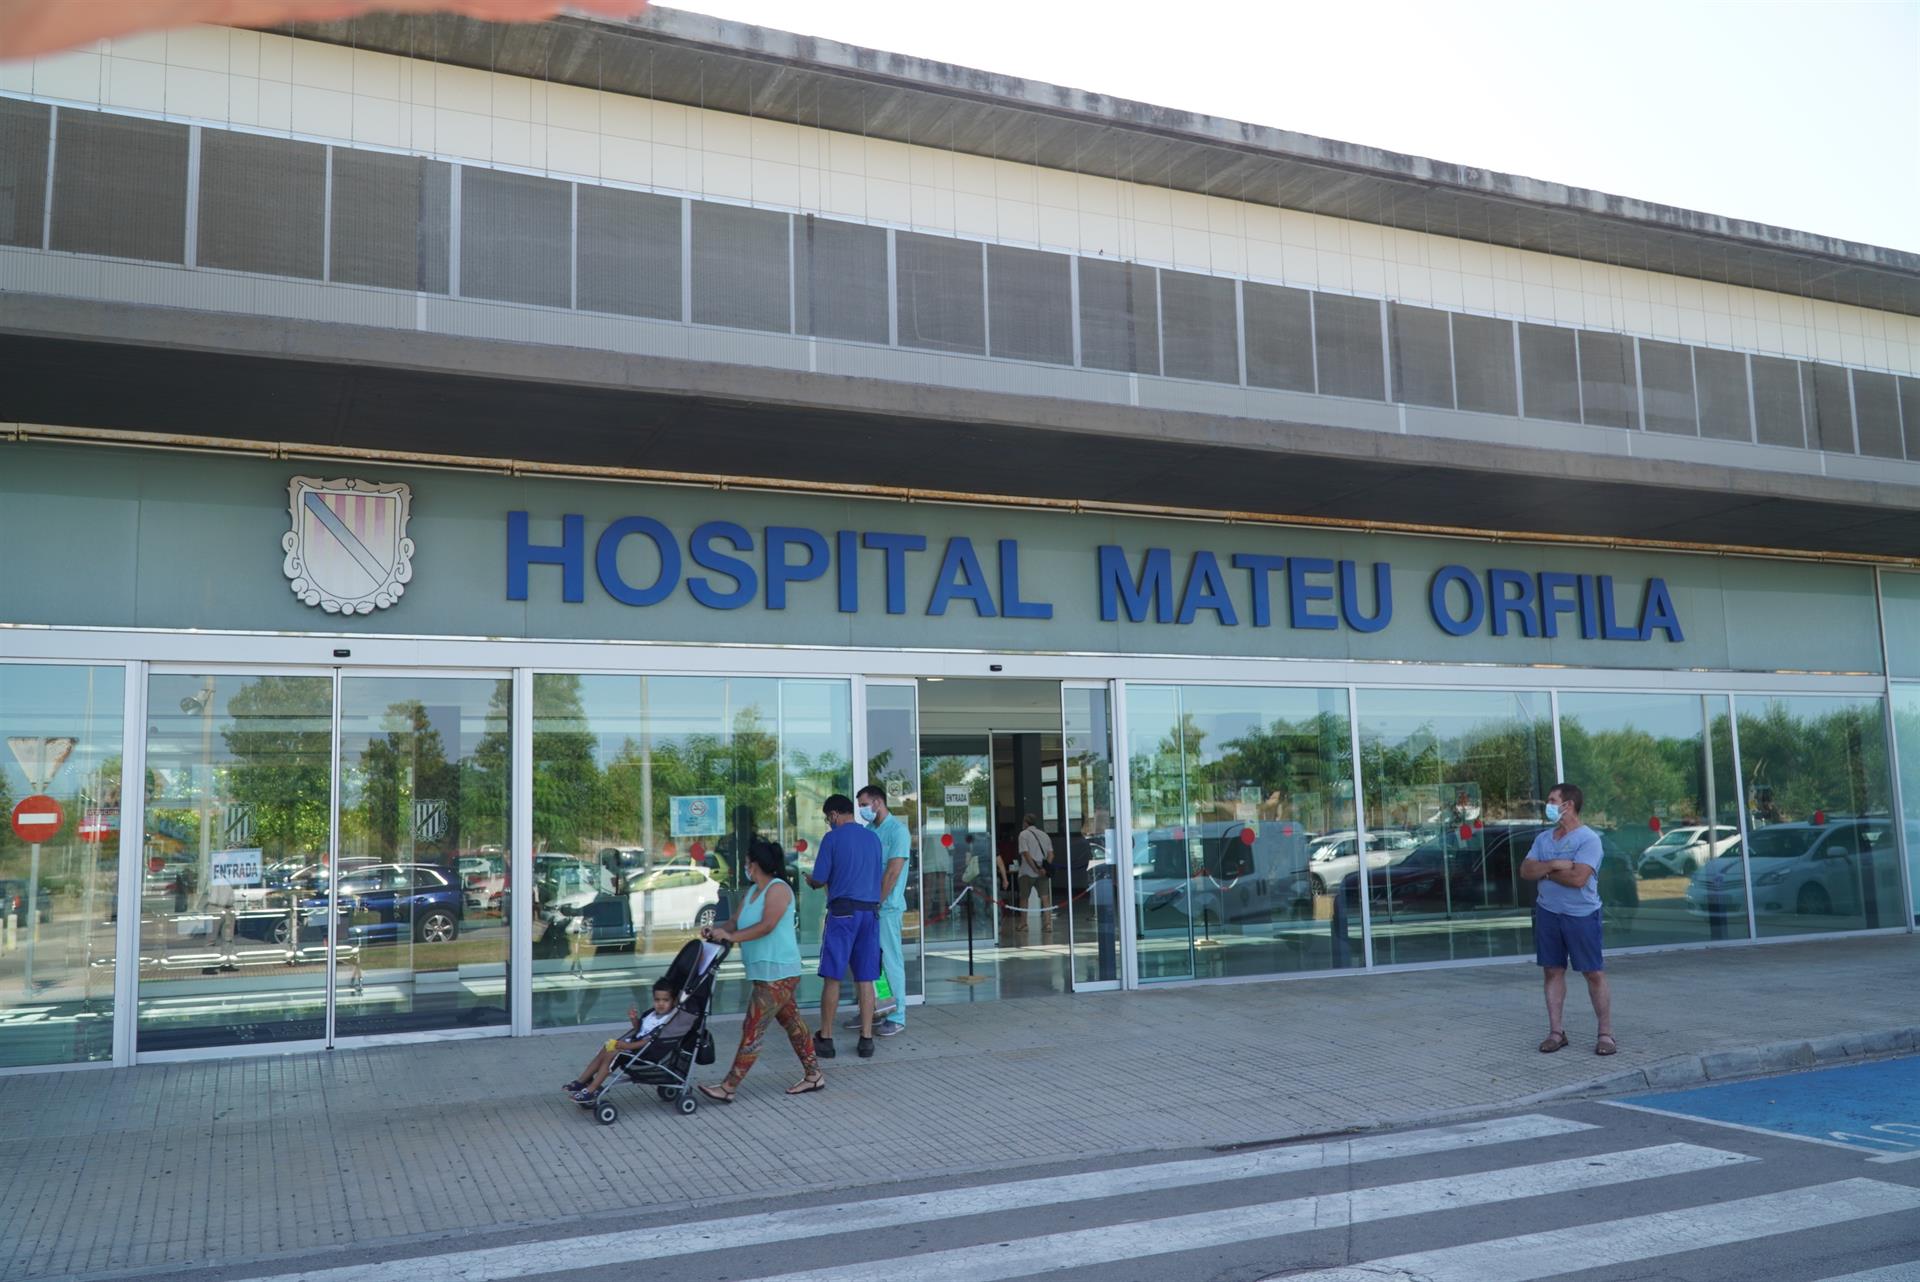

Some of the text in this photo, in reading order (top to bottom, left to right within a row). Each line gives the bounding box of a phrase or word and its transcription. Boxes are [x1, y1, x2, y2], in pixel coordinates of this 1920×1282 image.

[506, 510, 1685, 644] HOSPITAL MATEU ORFILA
[946, 793, 967, 802] ENTRADA
[213, 862, 258, 879] ENTRADA
